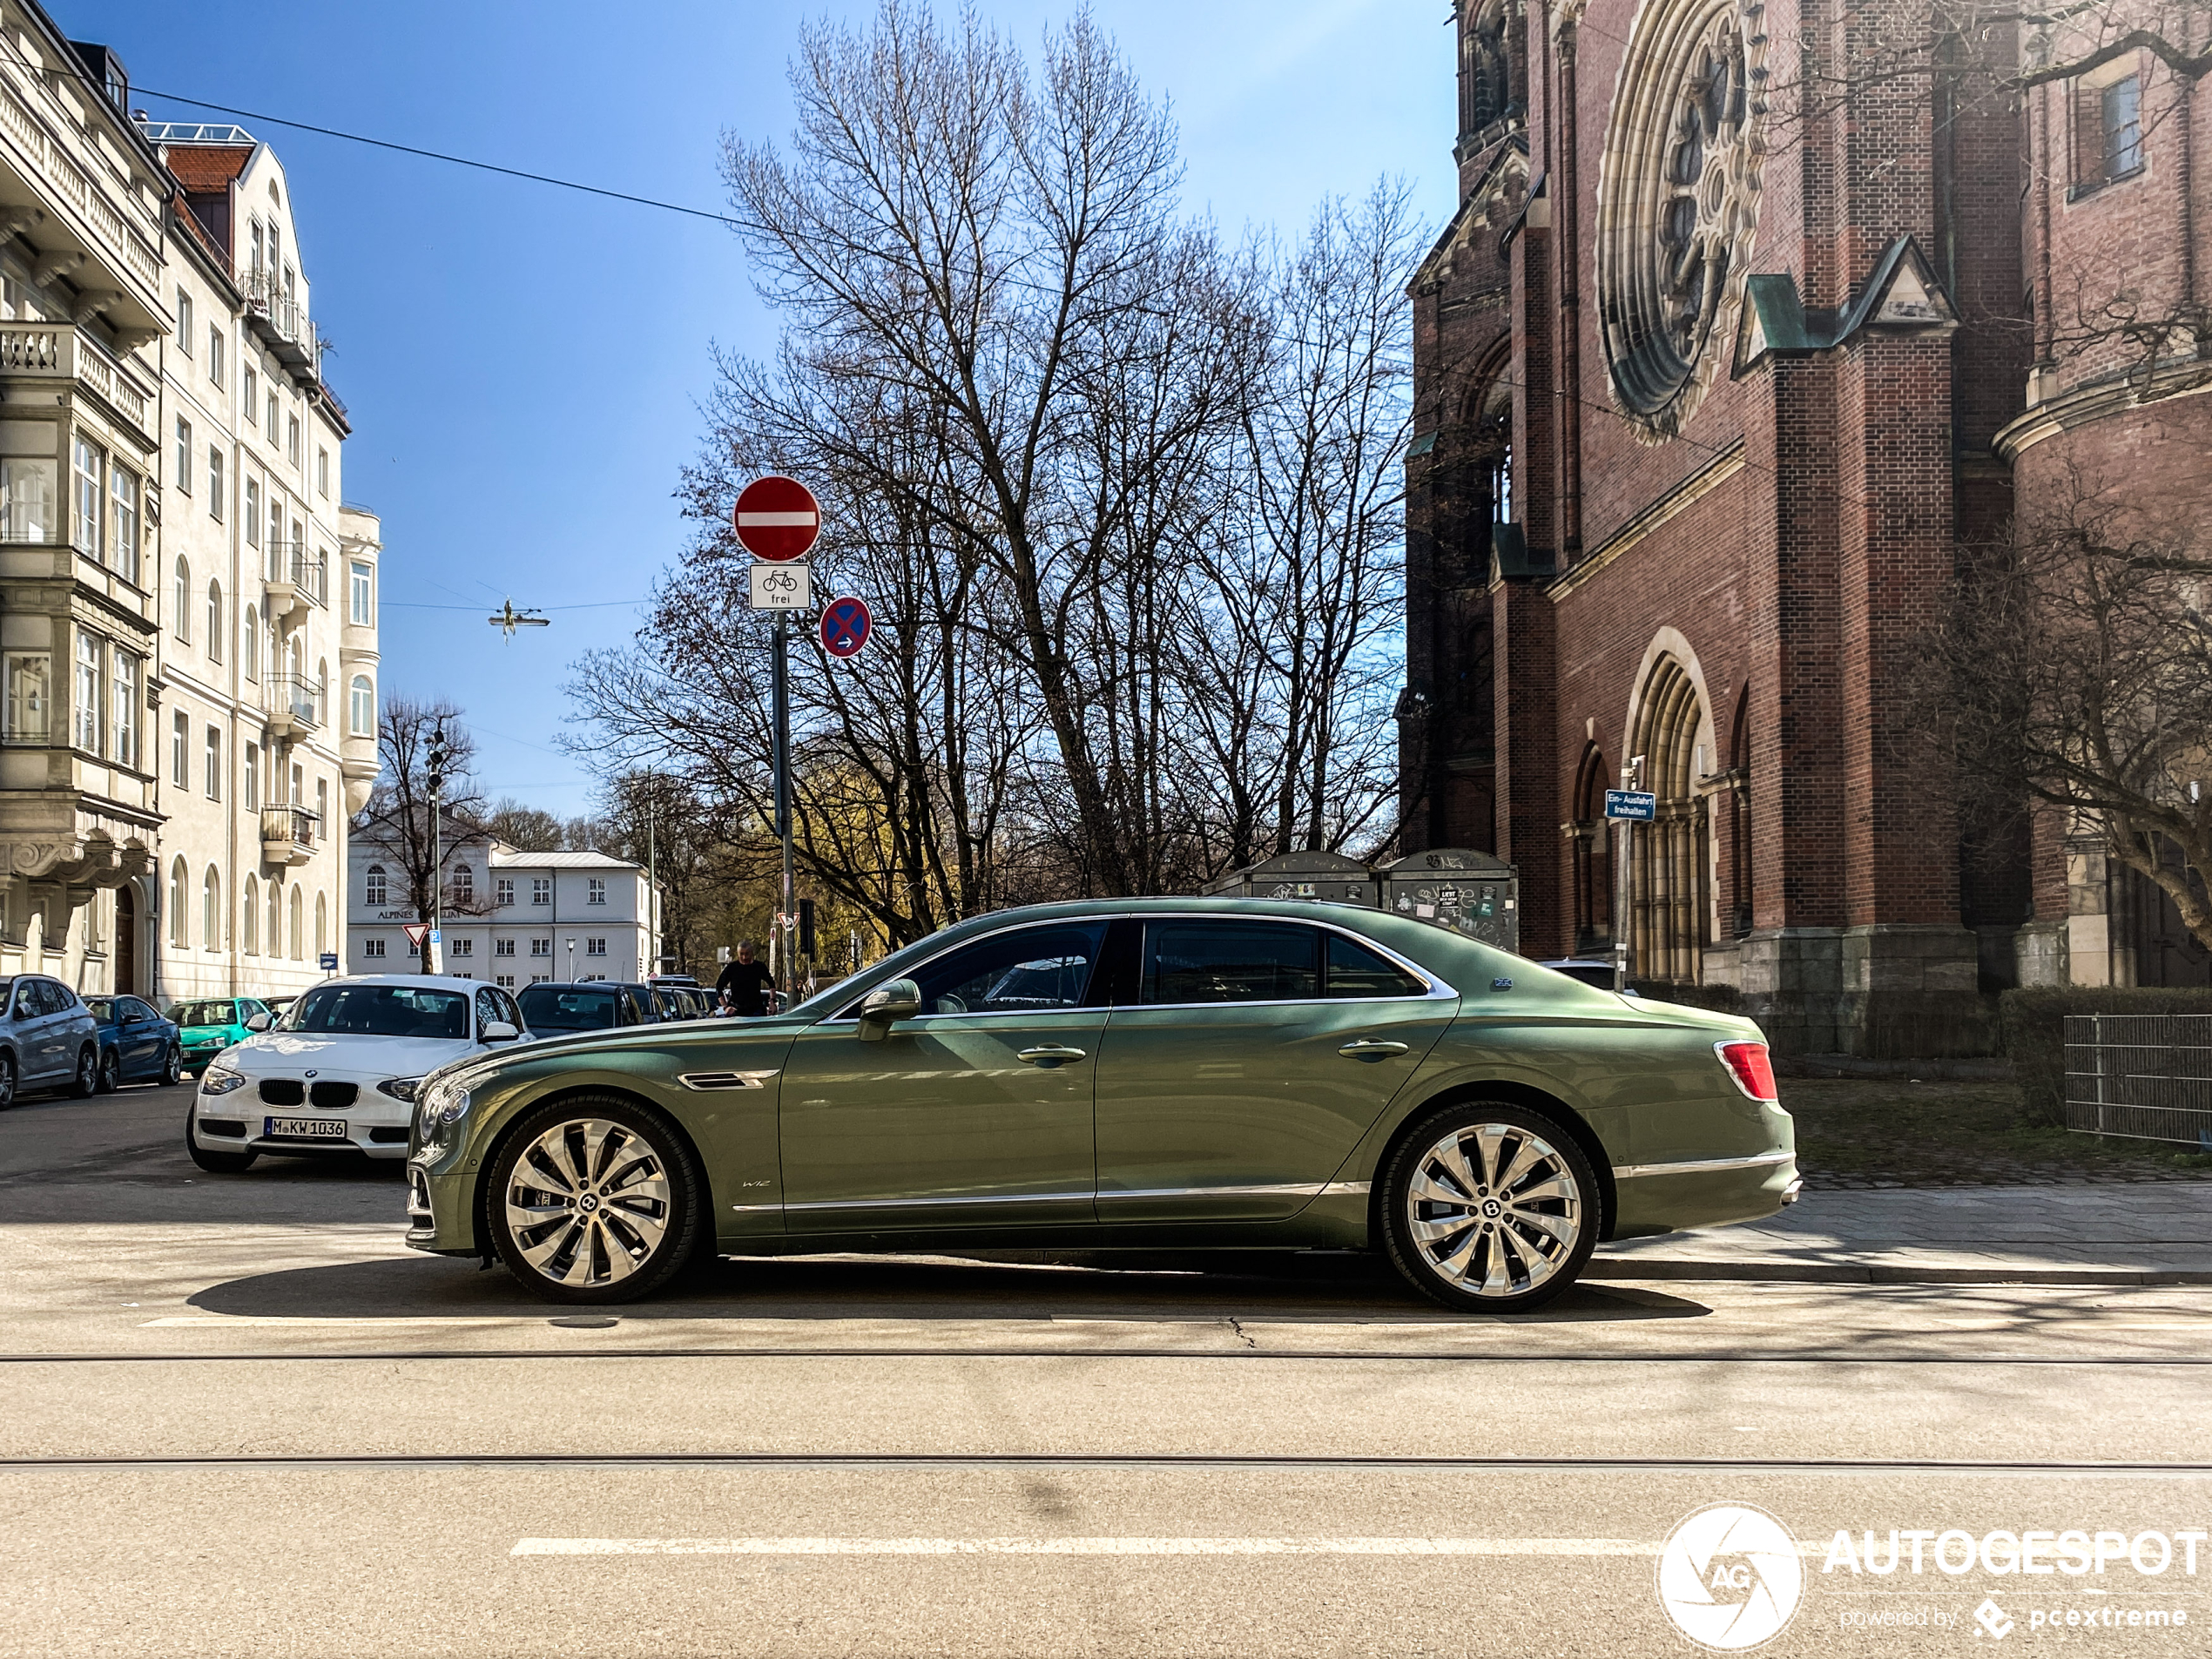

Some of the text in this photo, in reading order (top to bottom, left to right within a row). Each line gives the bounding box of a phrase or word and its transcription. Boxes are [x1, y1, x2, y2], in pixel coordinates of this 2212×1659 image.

[772, 594, 791, 604] frei
[1608, 793, 1653, 806] Ein- Ausfahrt
[1614, 805, 1647, 816] freihalten
[378, 910, 414, 920] ALPINES
[431, 932, 437, 942] P
[309, 1123, 343, 1136] 1036
